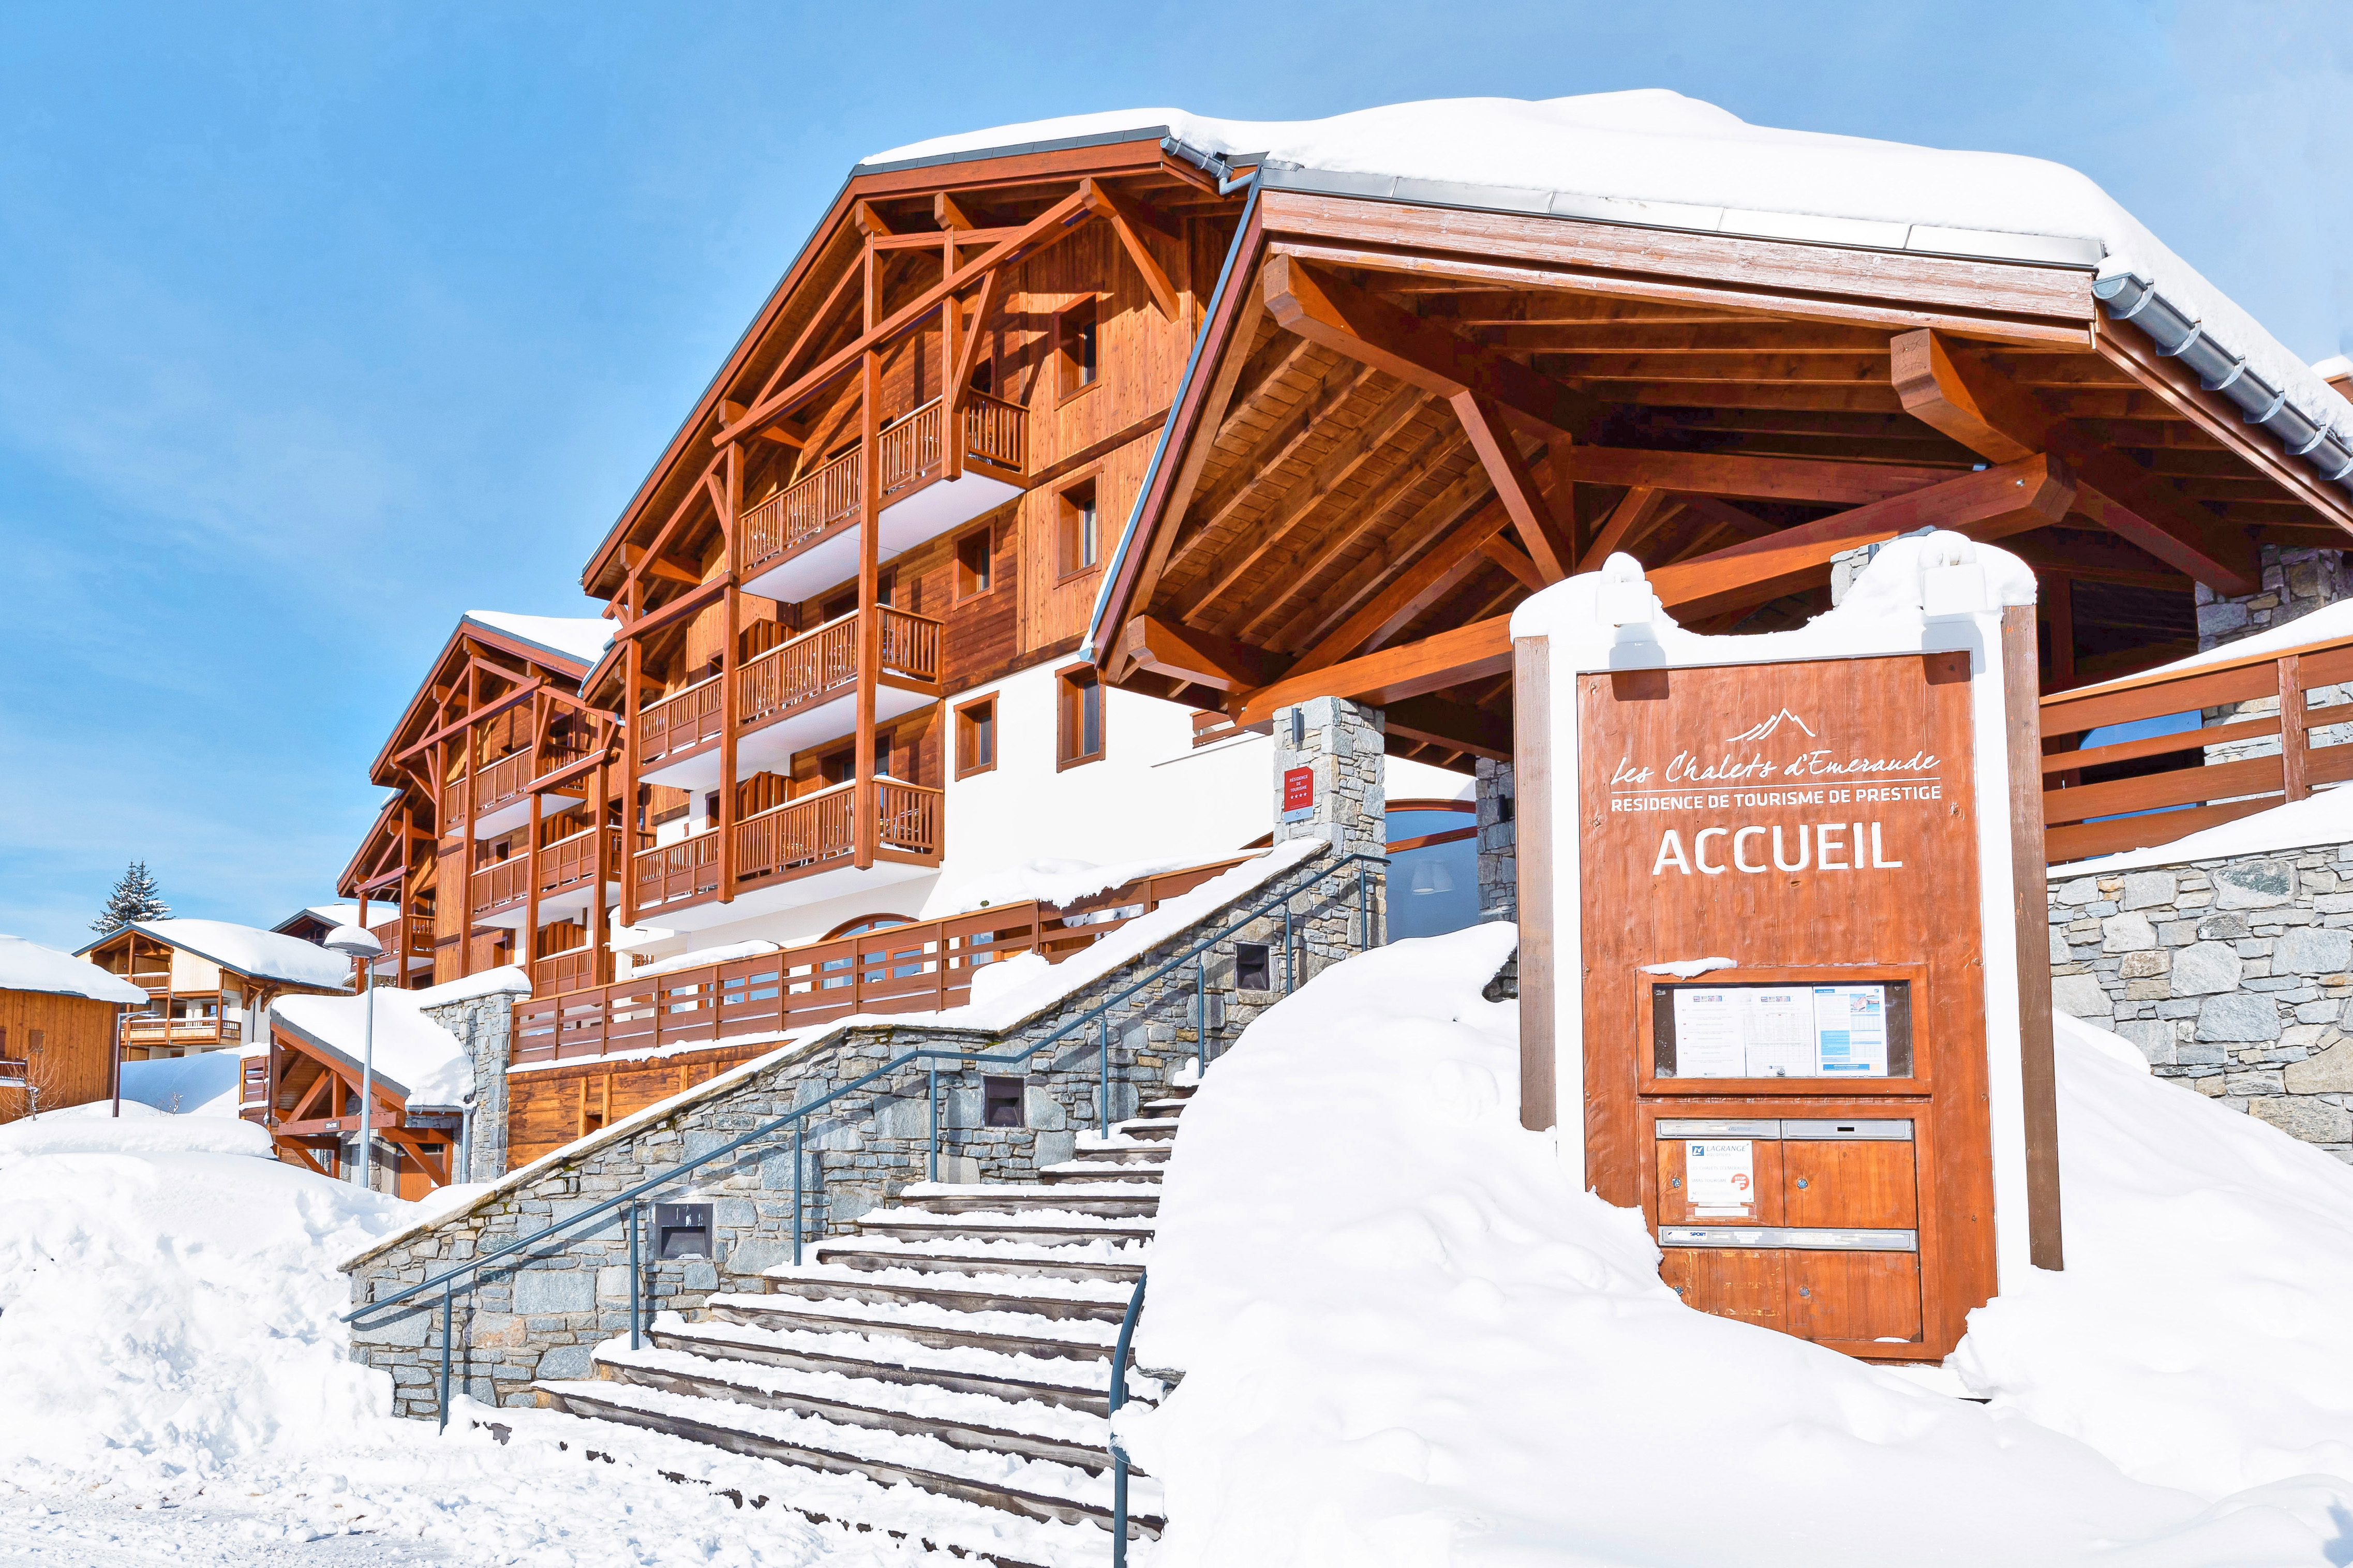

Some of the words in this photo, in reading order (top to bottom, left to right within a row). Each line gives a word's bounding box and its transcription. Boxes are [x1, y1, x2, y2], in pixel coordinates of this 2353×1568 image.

[1610, 756, 1655, 785] Les
[1665, 750, 1778, 783] Chalets
[1783, 750, 1941, 776] d'Emeraude
[1611, 796, 1703, 812] RESIDENCE
[1708, 794, 1730, 809] DE
[1733, 790, 1824, 808] TOURISME
[1829, 789, 1851, 803] DE
[1855, 785, 1941, 802] PRESTIGE
[1652, 822, 1903, 875] ACCUEIL
